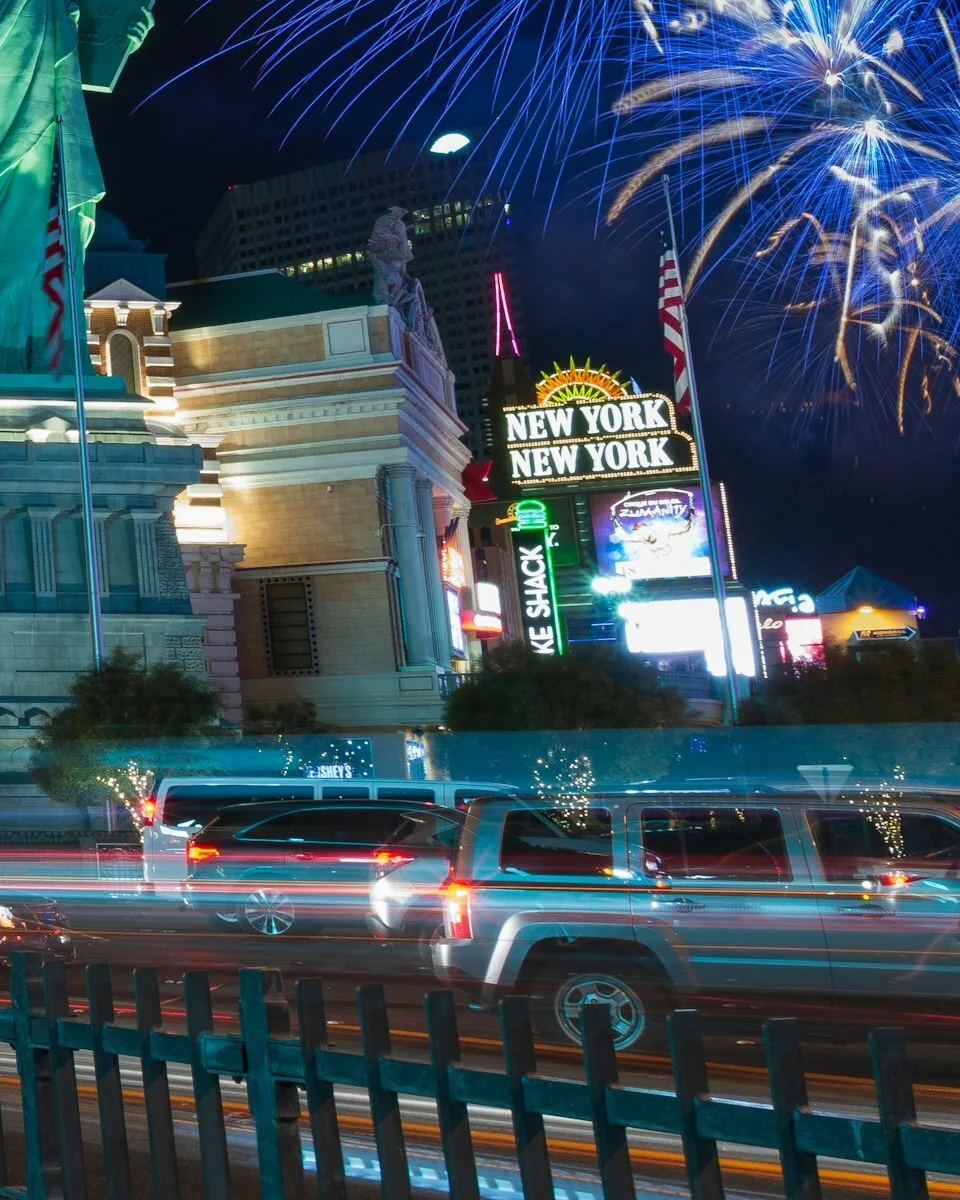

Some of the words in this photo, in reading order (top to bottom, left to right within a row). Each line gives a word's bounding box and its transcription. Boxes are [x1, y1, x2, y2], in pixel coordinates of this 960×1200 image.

[505, 407, 575, 442] NEW
[580, 399, 669, 435] YORK
[509, 444, 579, 479] NEW
[584, 436, 674, 472] YORK
[518, 544, 551, 619] SHACK
